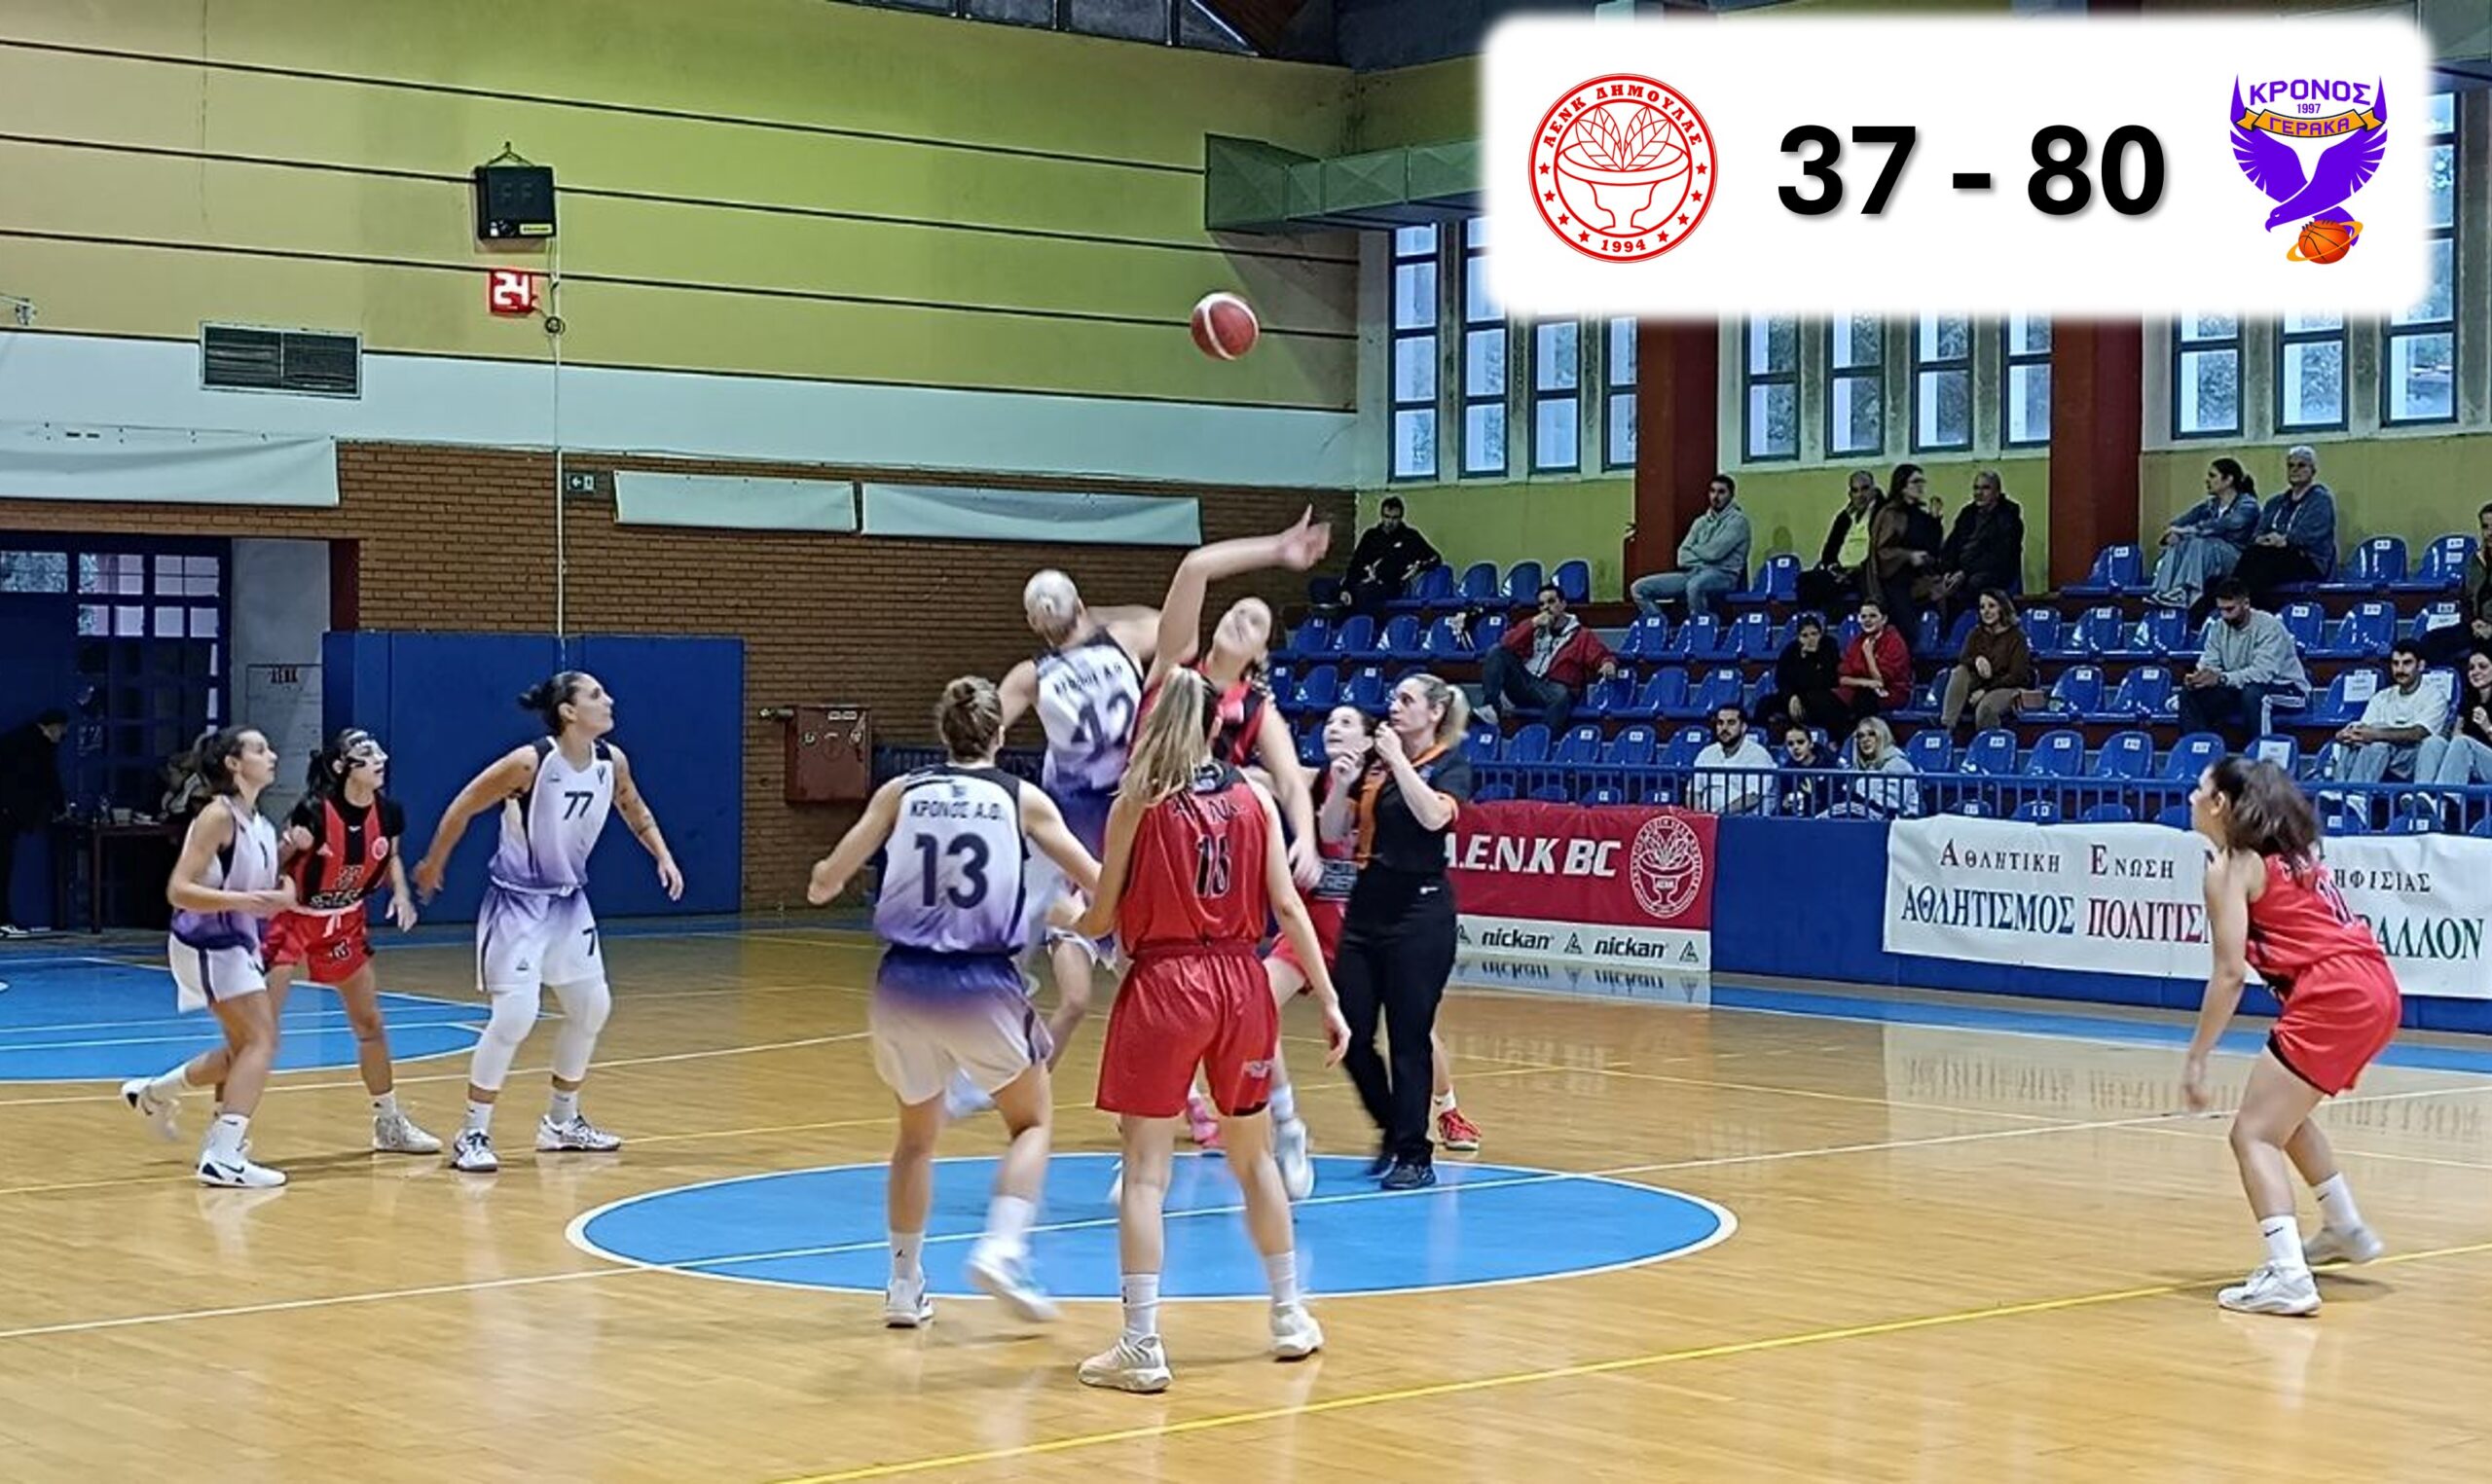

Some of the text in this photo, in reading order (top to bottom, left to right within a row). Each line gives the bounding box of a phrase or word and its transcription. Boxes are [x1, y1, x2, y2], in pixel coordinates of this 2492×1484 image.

[494, 271, 531, 306] 24
[564, 791, 594, 820] 77
[915, 832, 989, 909] 13
[1562, 837, 1622, 877] BC
[1900, 884, 2076, 934] ΑΘΛΗΤΙΣΜΟΣ
[1482, 927, 1551, 951] nickan
[1594, 936, 1666, 959] nickan
